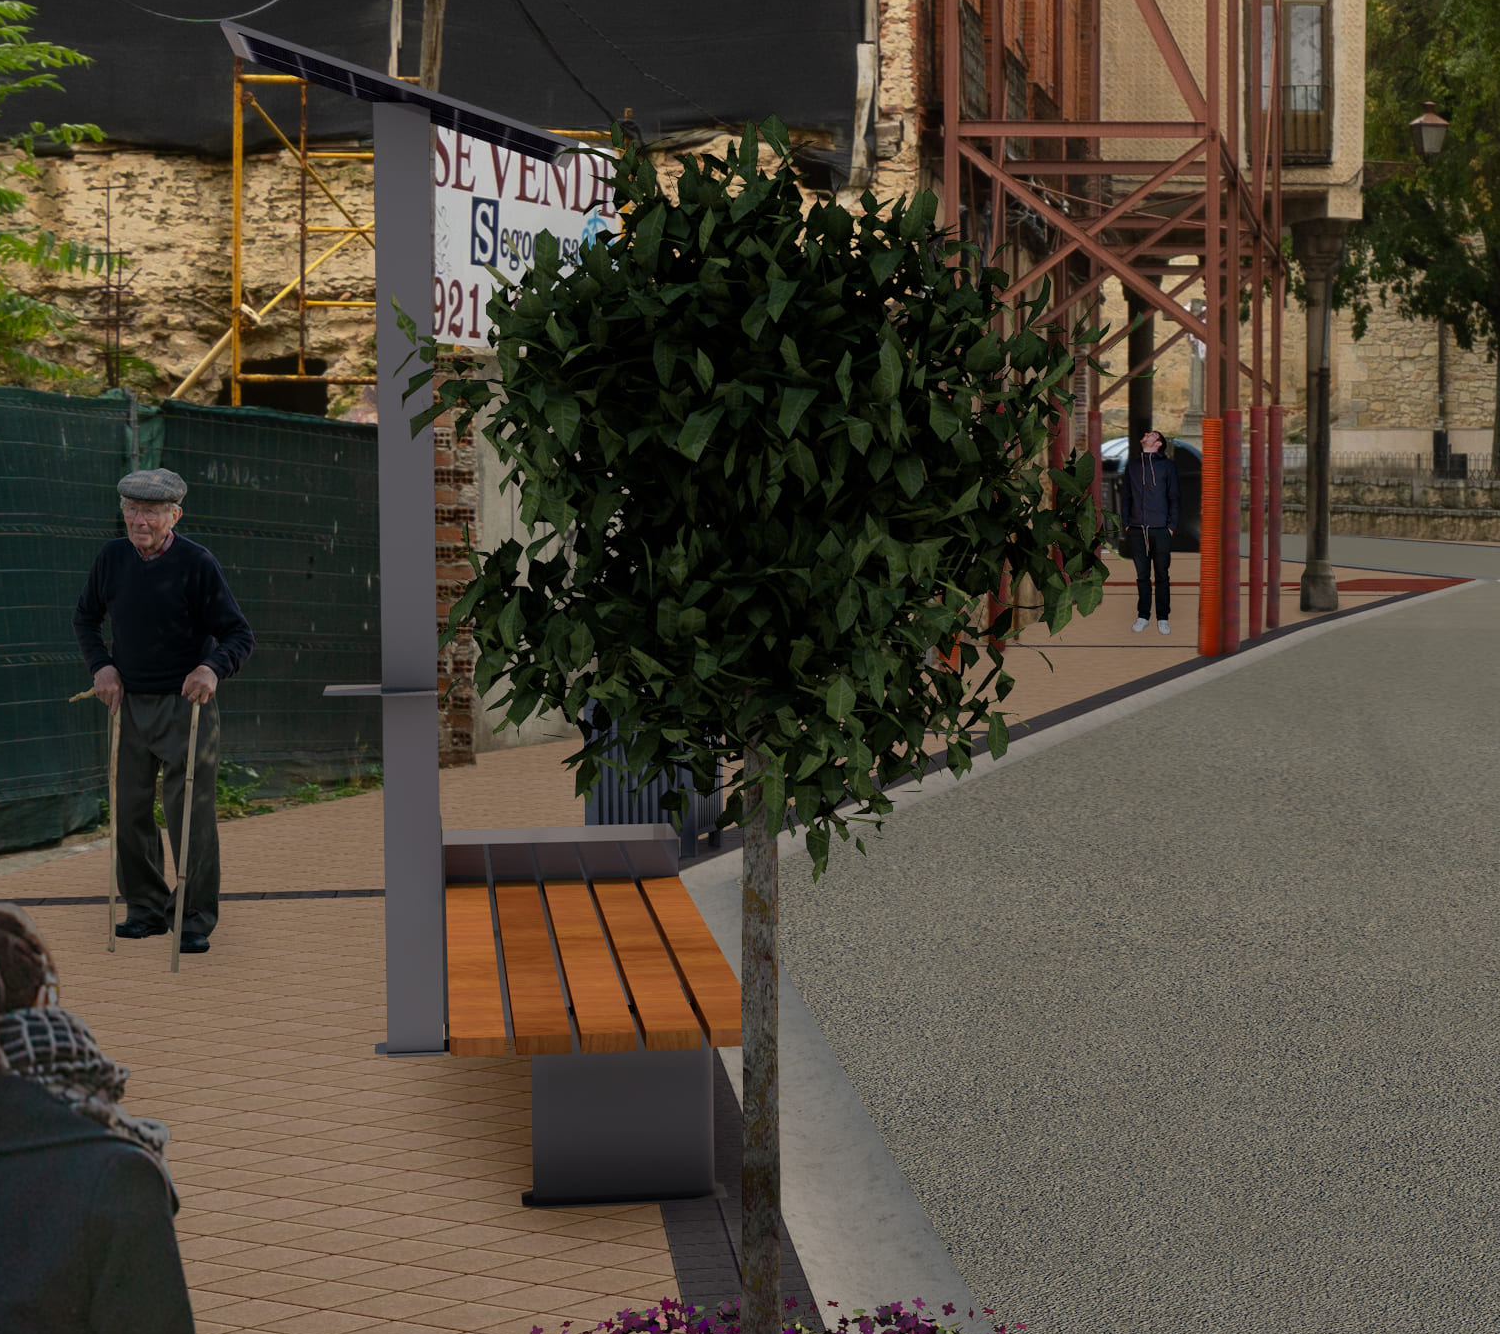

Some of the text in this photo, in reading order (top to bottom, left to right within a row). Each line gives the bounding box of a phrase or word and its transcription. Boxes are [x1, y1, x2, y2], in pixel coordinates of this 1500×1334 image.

[434, 125, 617, 219] SE VENDE
[433, 277, 482, 339] 921
